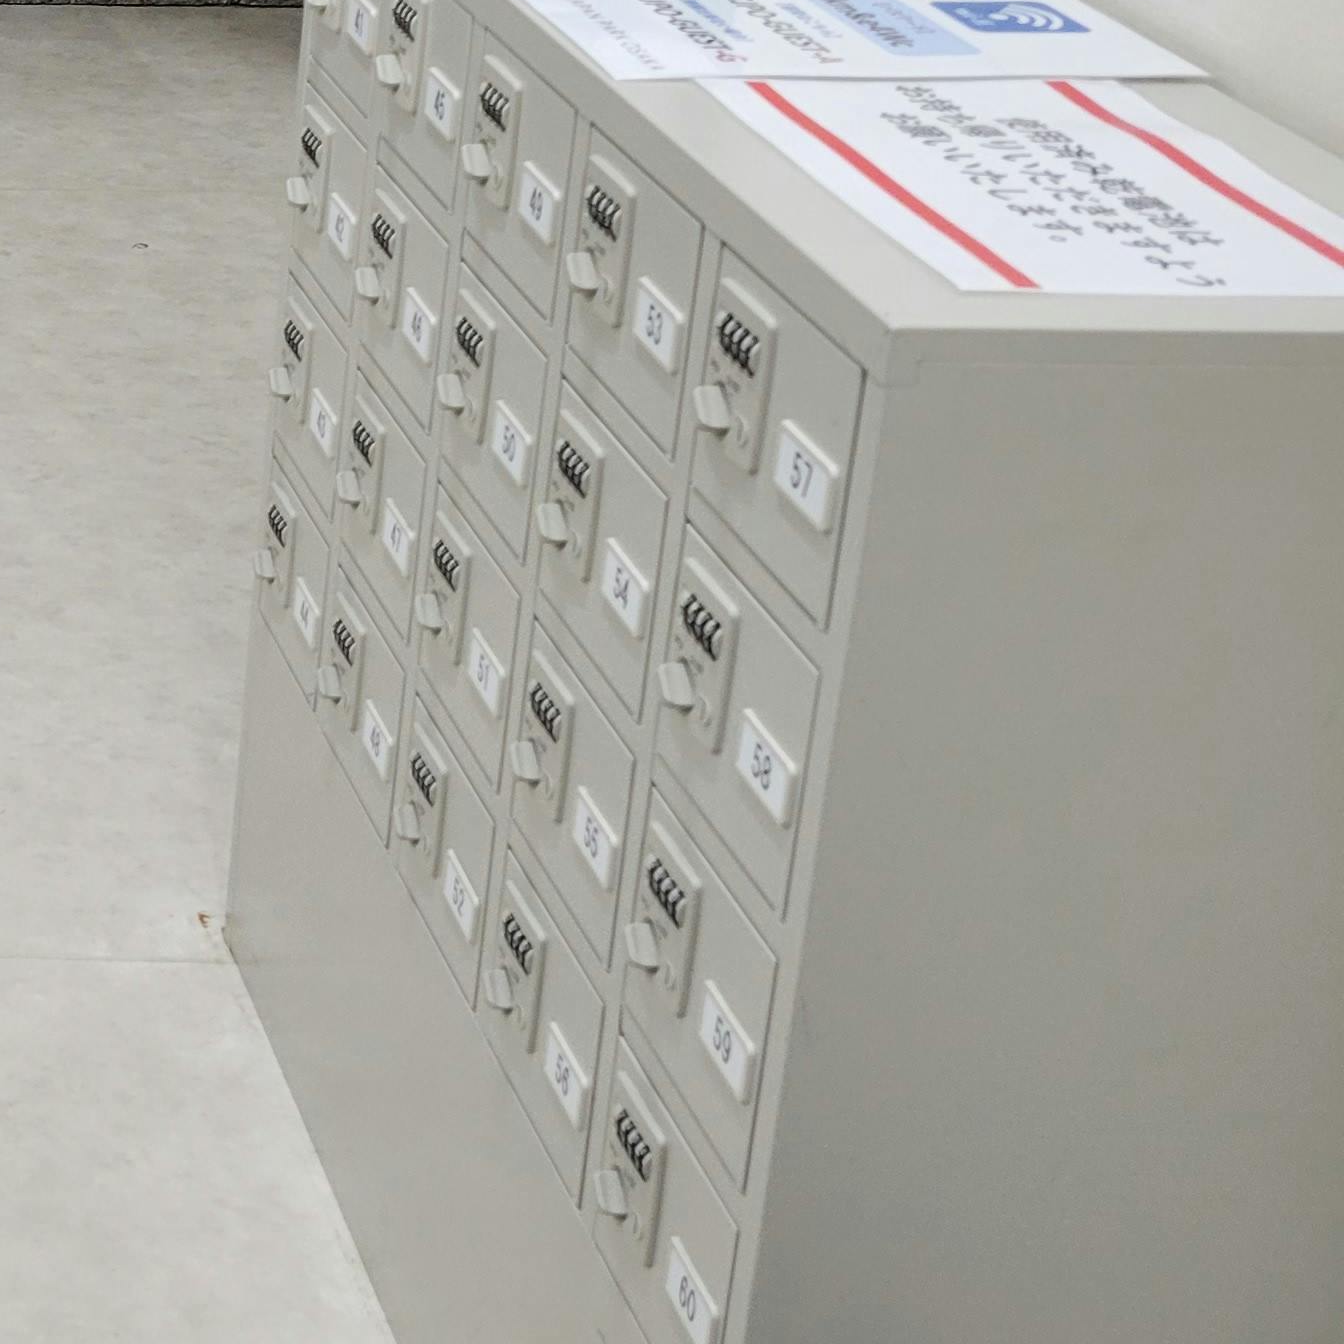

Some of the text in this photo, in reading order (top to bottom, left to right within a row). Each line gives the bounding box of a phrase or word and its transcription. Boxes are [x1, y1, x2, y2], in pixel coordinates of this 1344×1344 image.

[354, 9, 364, 37] 41
[434, 90, 446, 120] 45
[530, 187, 543, 221] 49
[646, 304, 663, 346] 53
[502, 425, 515, 462] 50
[791, 451, 814, 497] 57
[390, 521, 401, 552] 47
[614, 567, 630, 609] 54
[477, 653, 489, 690] 51
[752, 741, 772, 791] 58
[584, 816, 599, 858] 55
[453, 875, 465, 914] 52
[713, 1015, 732, 1065] 59
[555, 1052, 570, 1097] 56
[679, 1274, 697, 1323] 60
